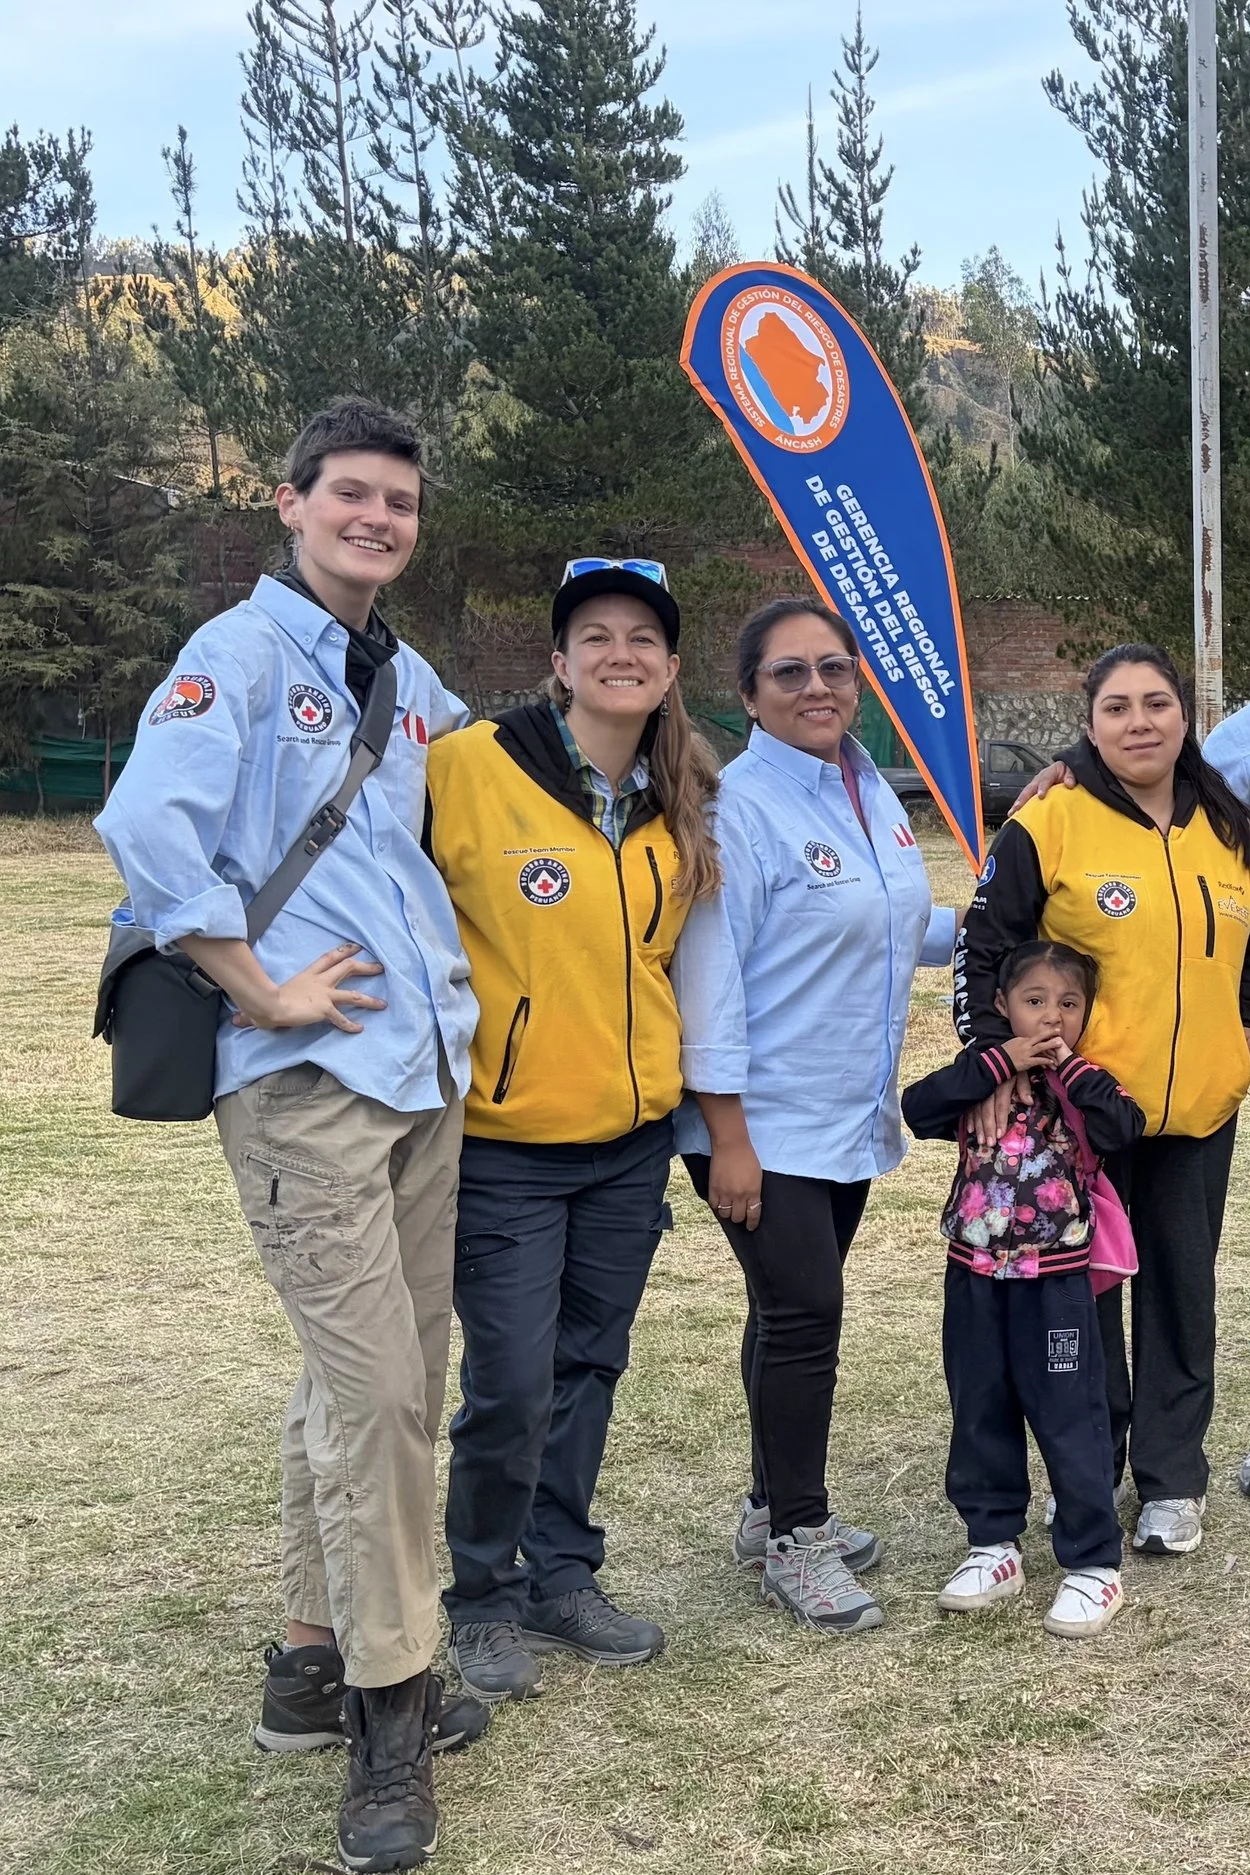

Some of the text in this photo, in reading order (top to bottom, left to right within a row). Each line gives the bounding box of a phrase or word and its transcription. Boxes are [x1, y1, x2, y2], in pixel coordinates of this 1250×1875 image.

[726, 289, 845, 429] SISTEMA REGIONAL DE GESTIÓN DEL RIESGO DE DESASTRES
[805, 474, 947, 720] DE GESTIÓN DEL RIESGO
[811, 531, 905, 684] DE DESASTRES
[836, 484, 957, 697] GERENCIA REGIONAL
[277, 735, 299, 743] Search
[296, 720, 327, 732] PERUANO
[521, 859, 569, 886] SOCORRO ANDINO
[530, 891, 563, 904] PERUANO
